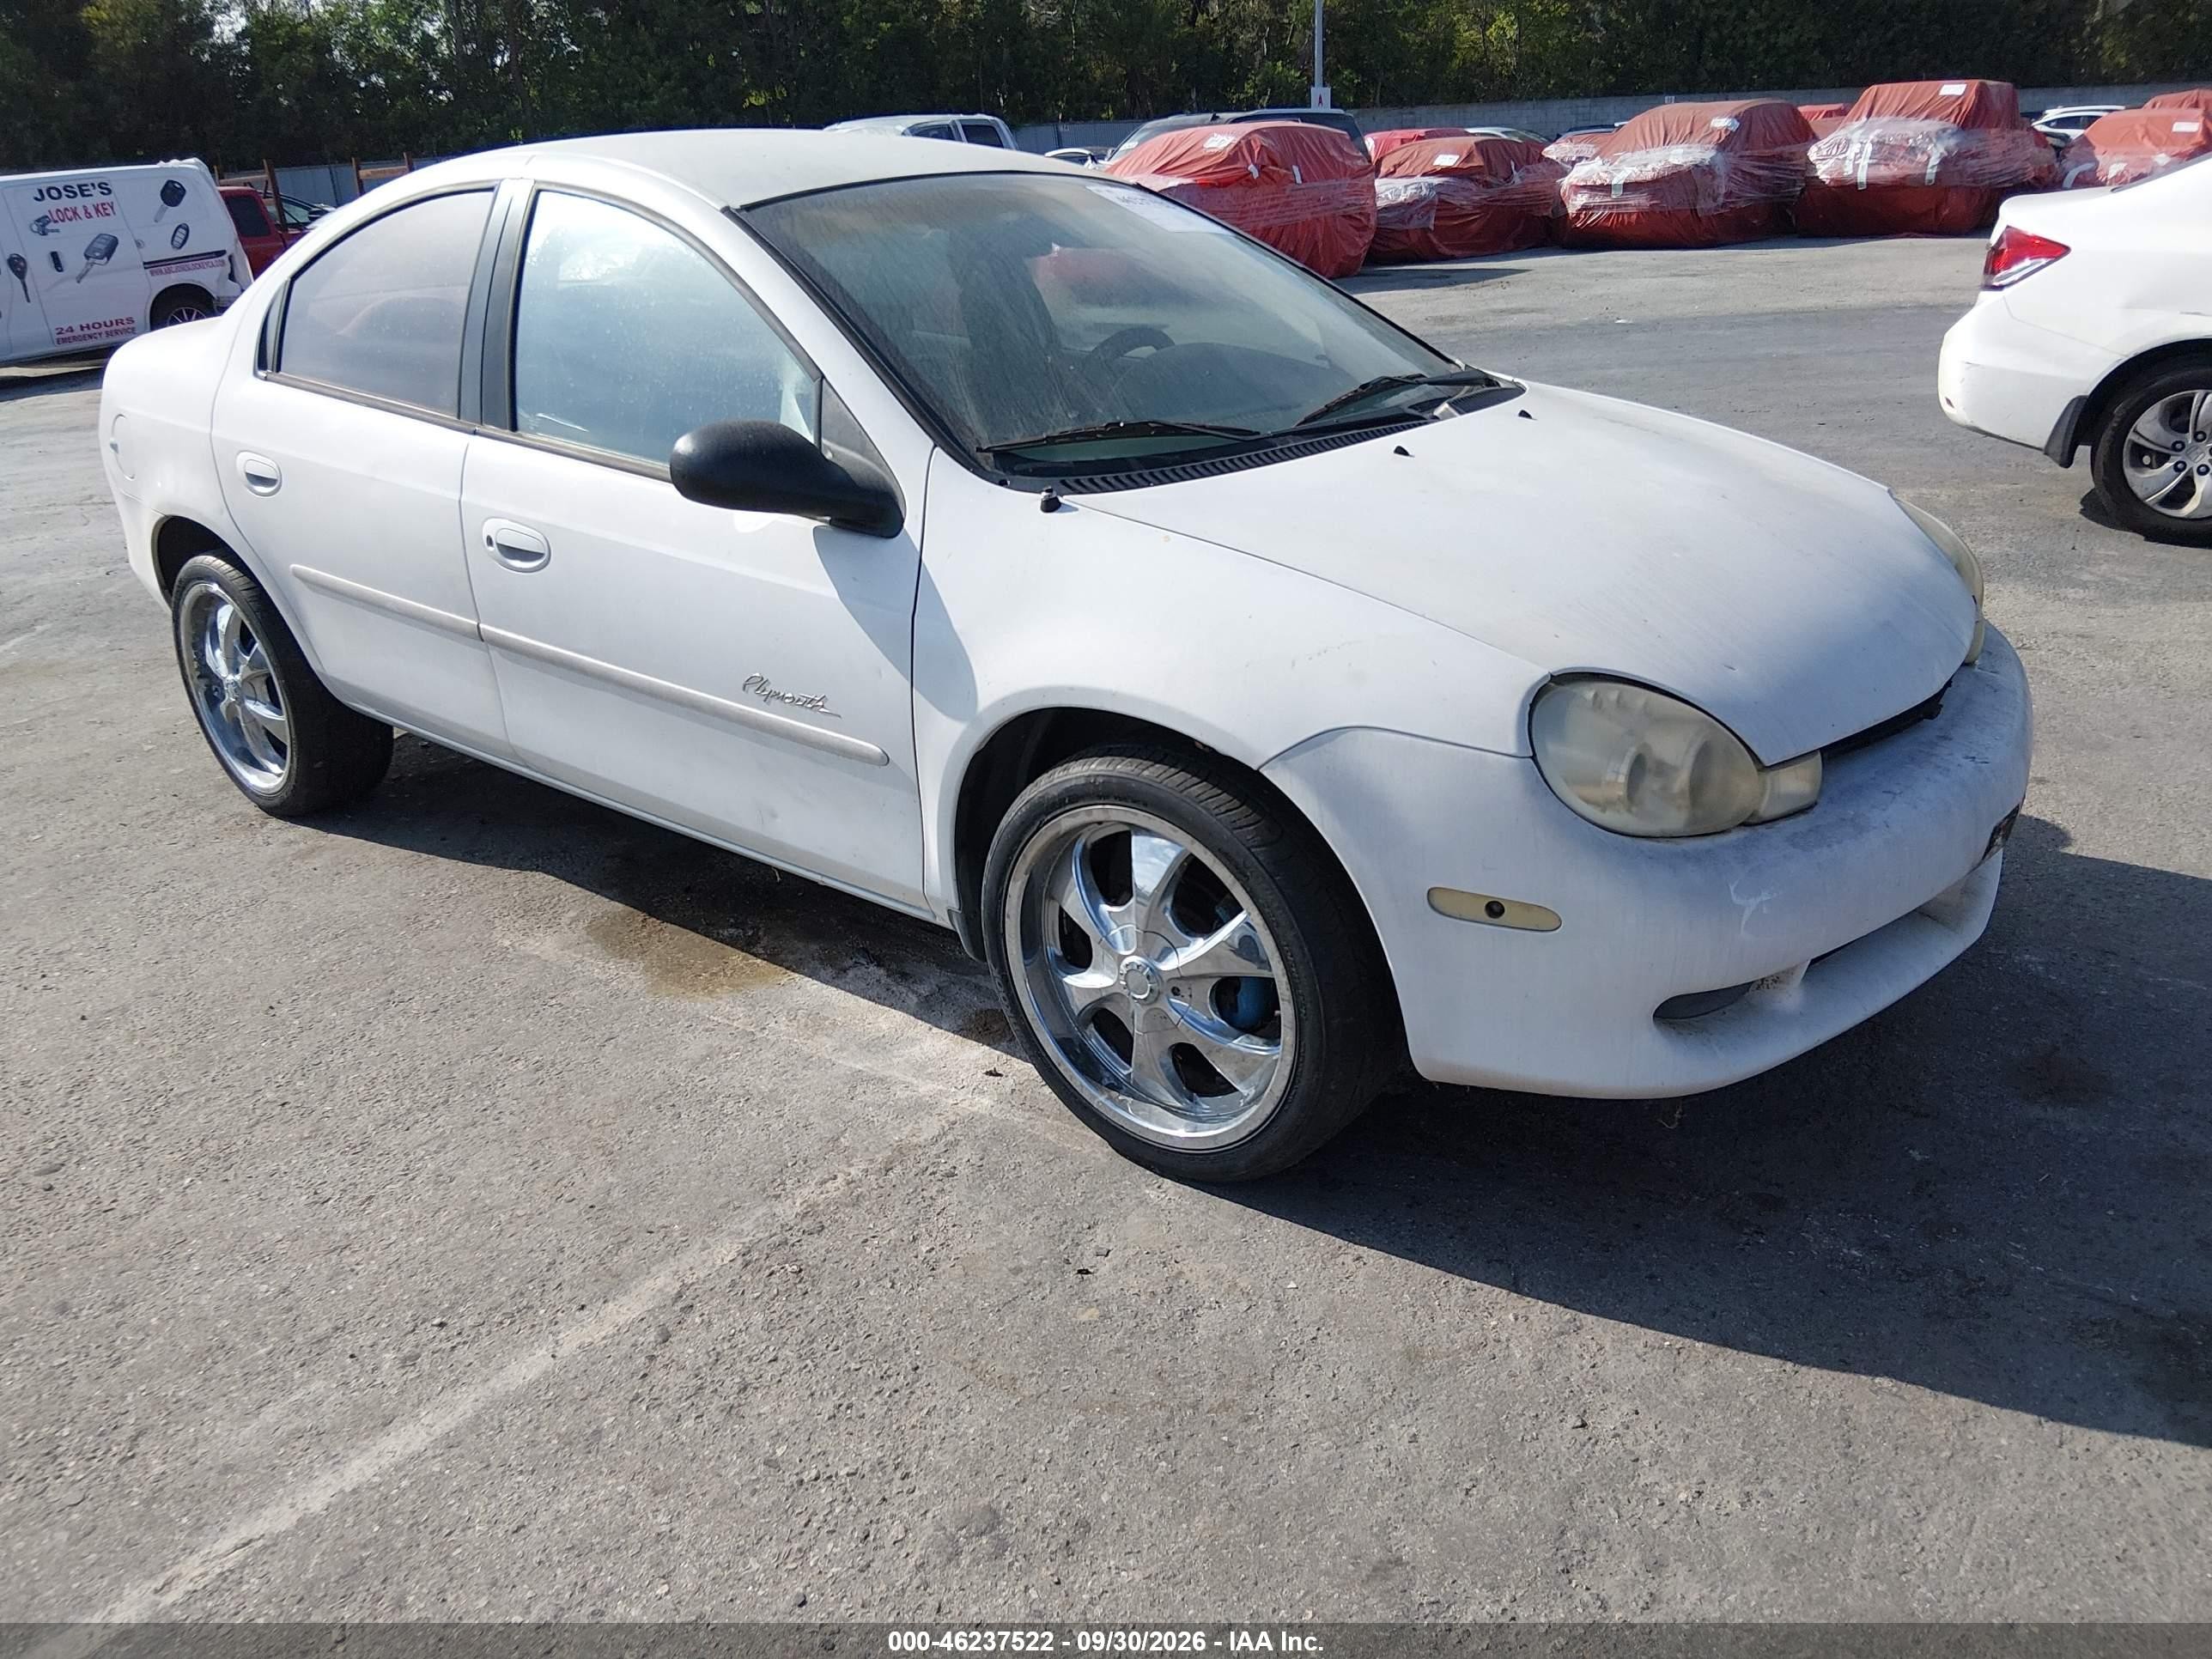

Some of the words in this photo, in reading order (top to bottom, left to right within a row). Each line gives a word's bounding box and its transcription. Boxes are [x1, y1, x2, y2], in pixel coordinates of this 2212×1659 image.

[33, 181, 112, 202] JOSE'S
[48, 207, 82, 223] LOCK
[82, 204, 93, 219] &
[93, 202, 116, 217] KEY
[55, 326, 75, 335] 24
[79, 317, 135, 331] HOURS
[742, 672, 842, 718] Plymouth
